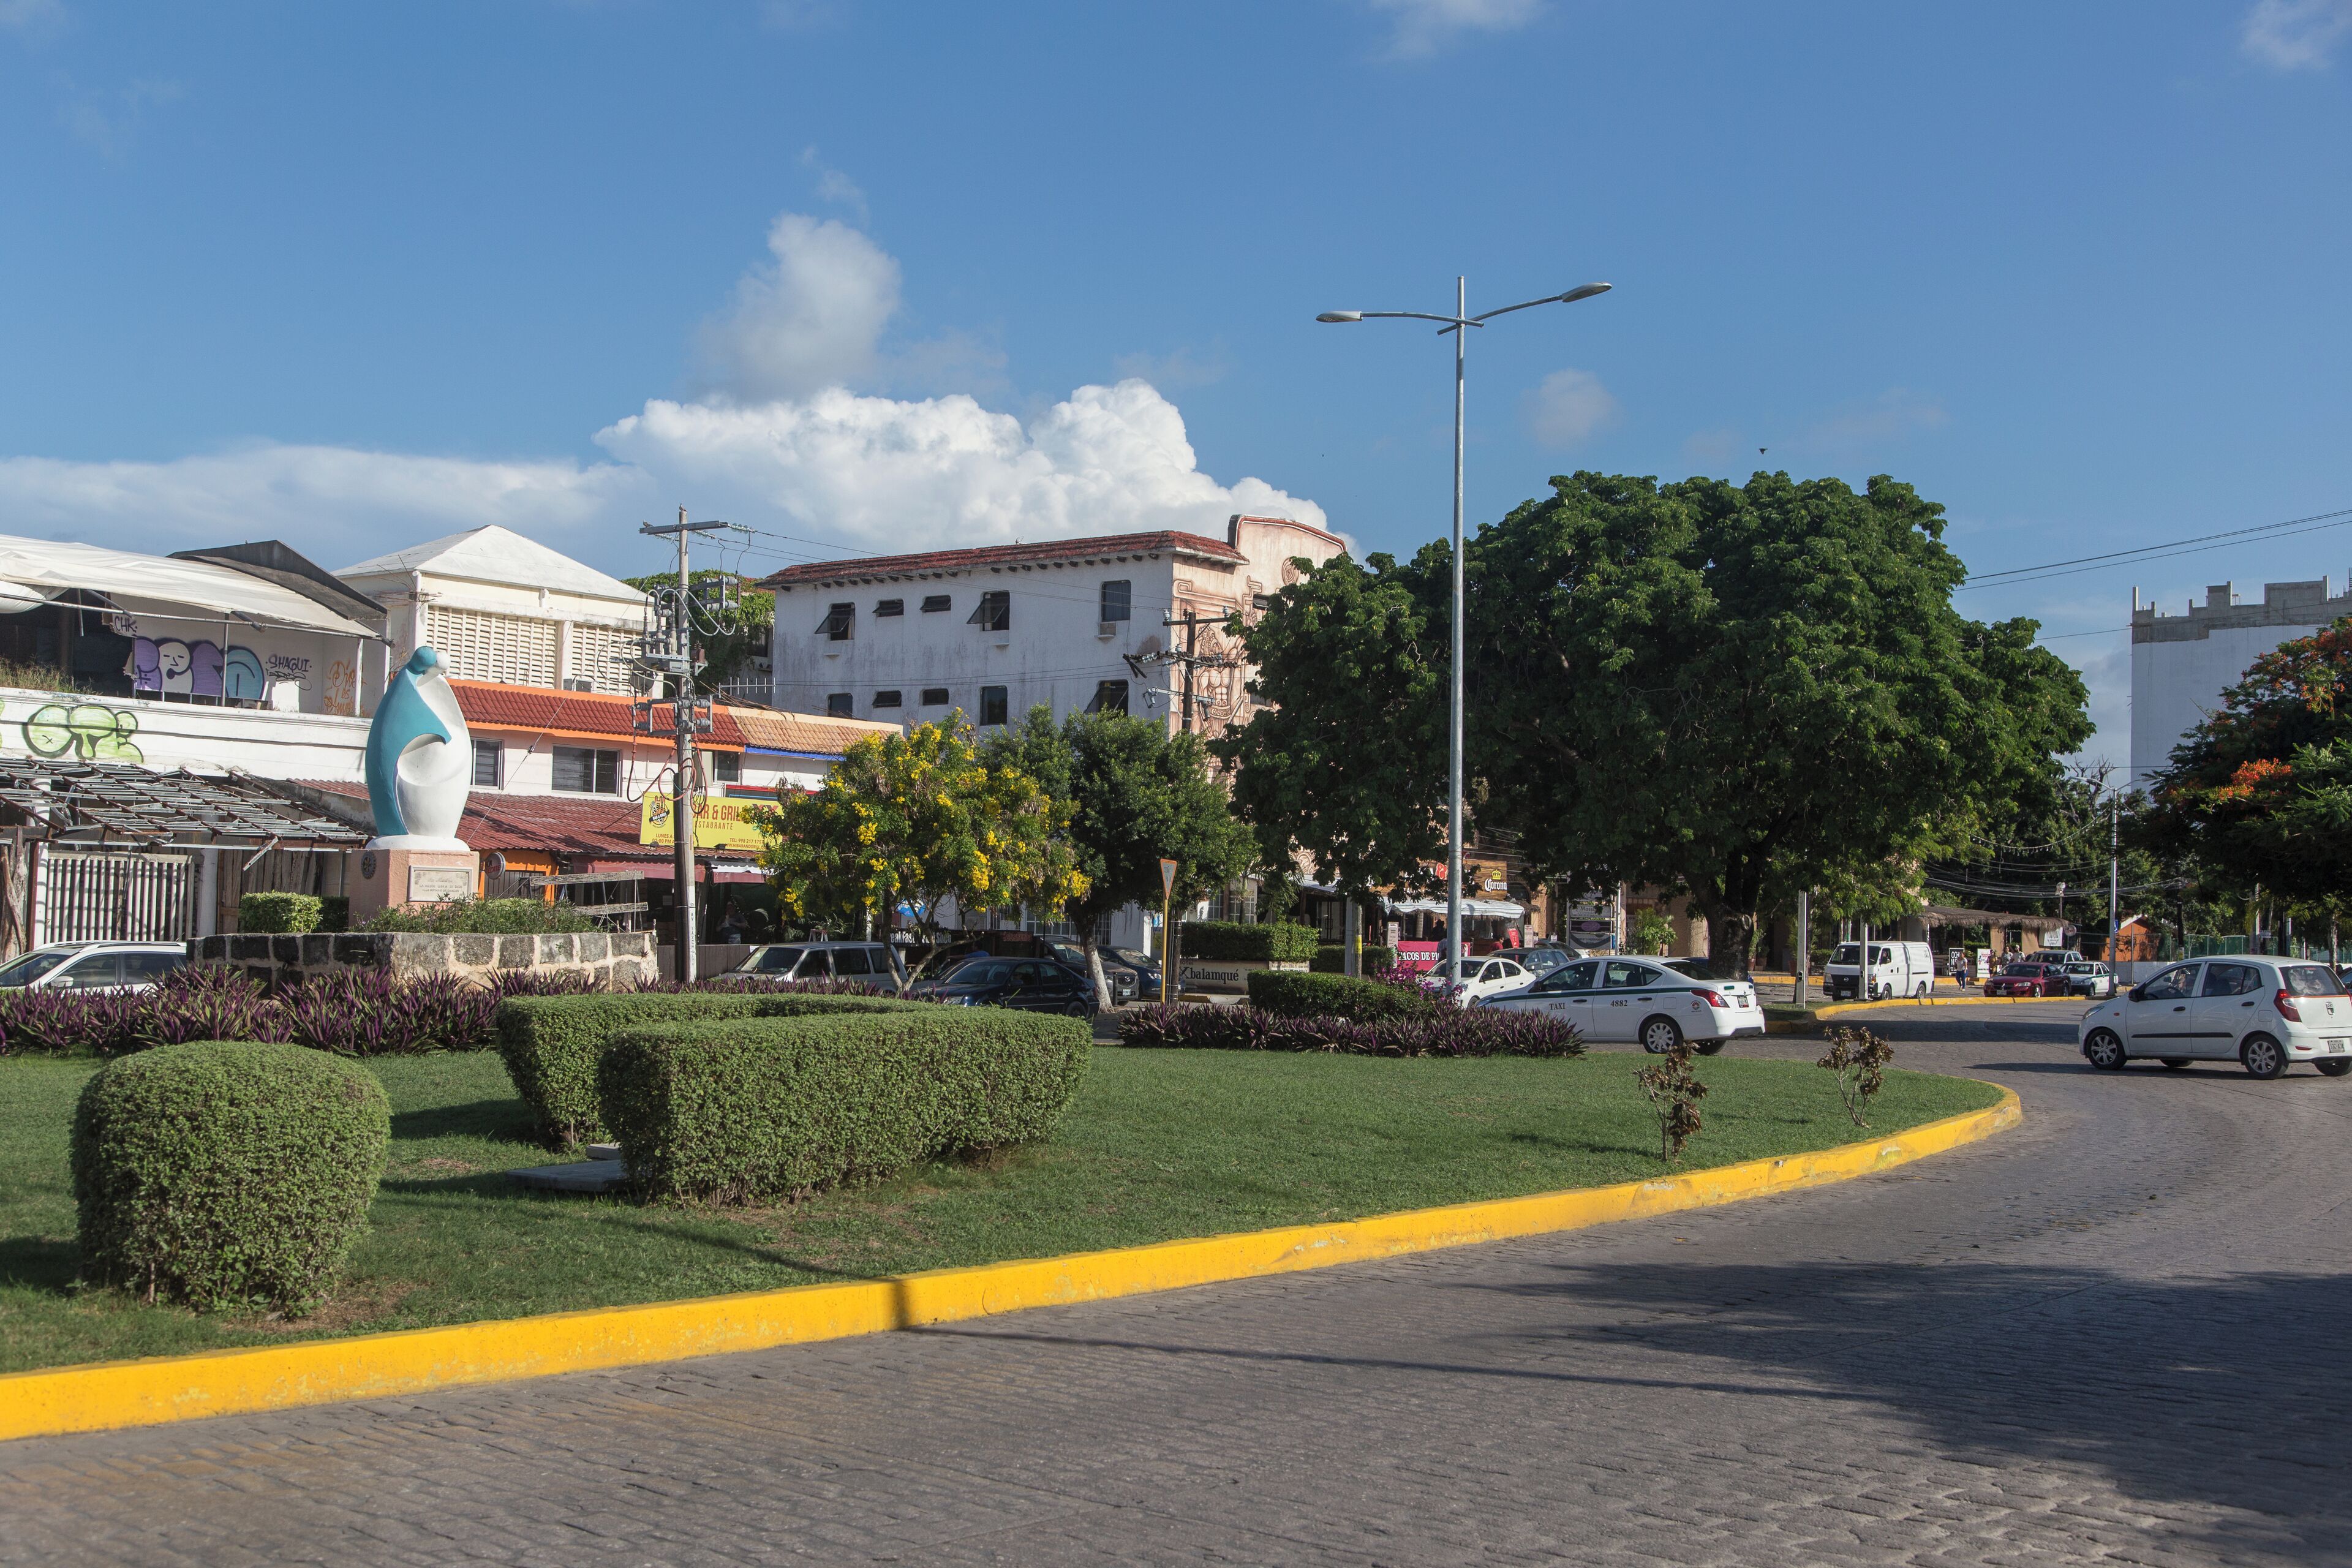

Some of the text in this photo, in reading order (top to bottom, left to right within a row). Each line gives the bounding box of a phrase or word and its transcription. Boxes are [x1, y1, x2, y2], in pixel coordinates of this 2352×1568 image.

[712, 804, 718, 820] &
[721, 805, 744, 822] GRIL
[694, 821, 734, 831] ESTAURANTE
[1484, 878, 1507, 892] Corona
[890, 931, 916, 944] eakFast
[1420, 952, 1430, 960] DE
[1179, 966, 1239, 984] Xbalamqué
